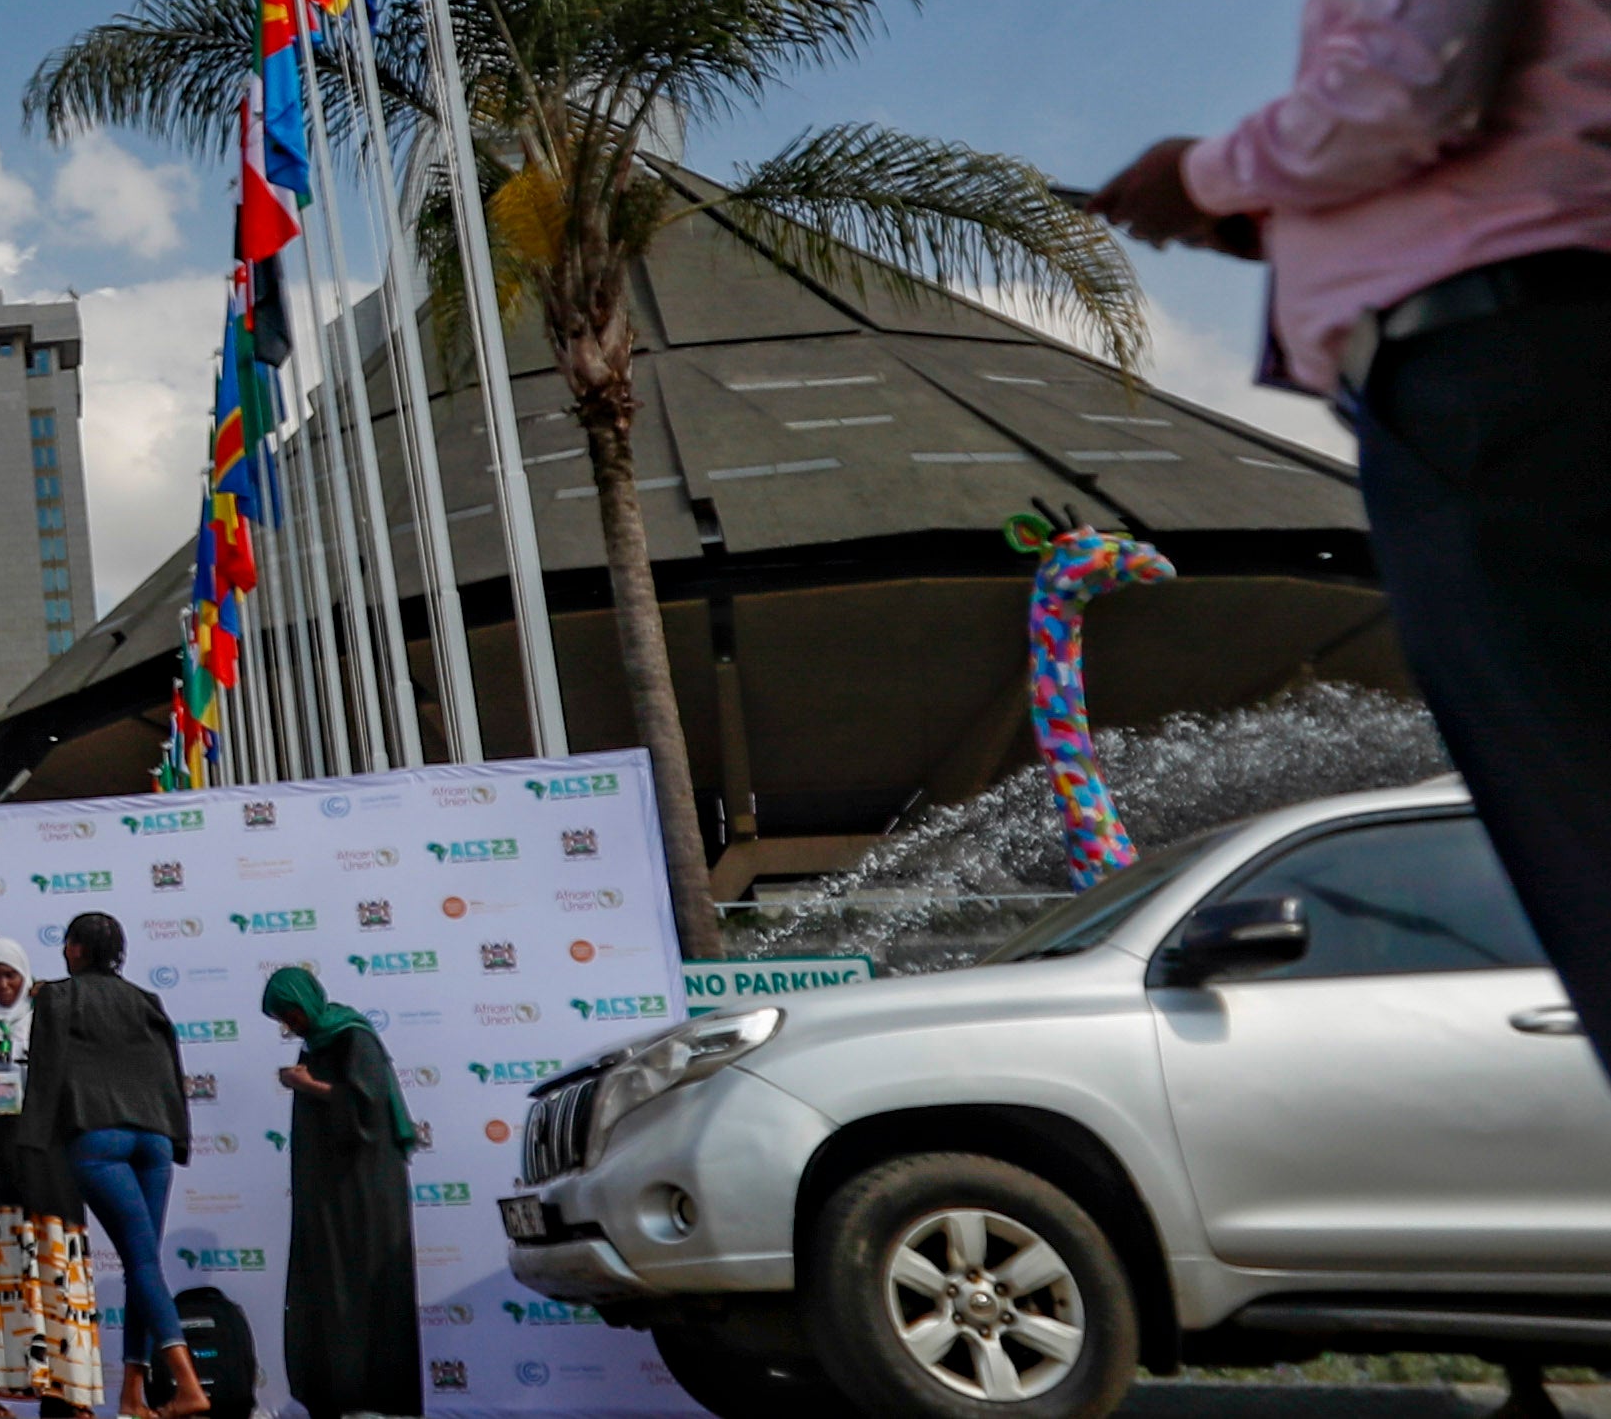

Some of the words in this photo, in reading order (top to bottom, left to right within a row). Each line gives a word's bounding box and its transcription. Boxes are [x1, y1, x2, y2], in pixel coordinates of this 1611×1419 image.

[432, 785, 471, 797] African
[549, 773, 619, 795] ACS23
[439, 796, 472, 808] Union
[142, 809, 204, 831] ACS23
[450, 838, 518, 858] ACS23
[51, 870, 112, 890] ACS23
[555, 889, 595, 902] African
[563, 901, 597, 912] Union
[251, 909, 316, 929] ACS23
[371, 951, 438, 972] ACS23
[685, 975, 726, 996] NO
[474, 1003, 513, 1016] African
[594, 995, 666, 1016] ACS23
[480, 1014, 515, 1026] Union
[411, 1182, 471, 1202] CS23
[201, 1249, 266, 1267] ACS23
